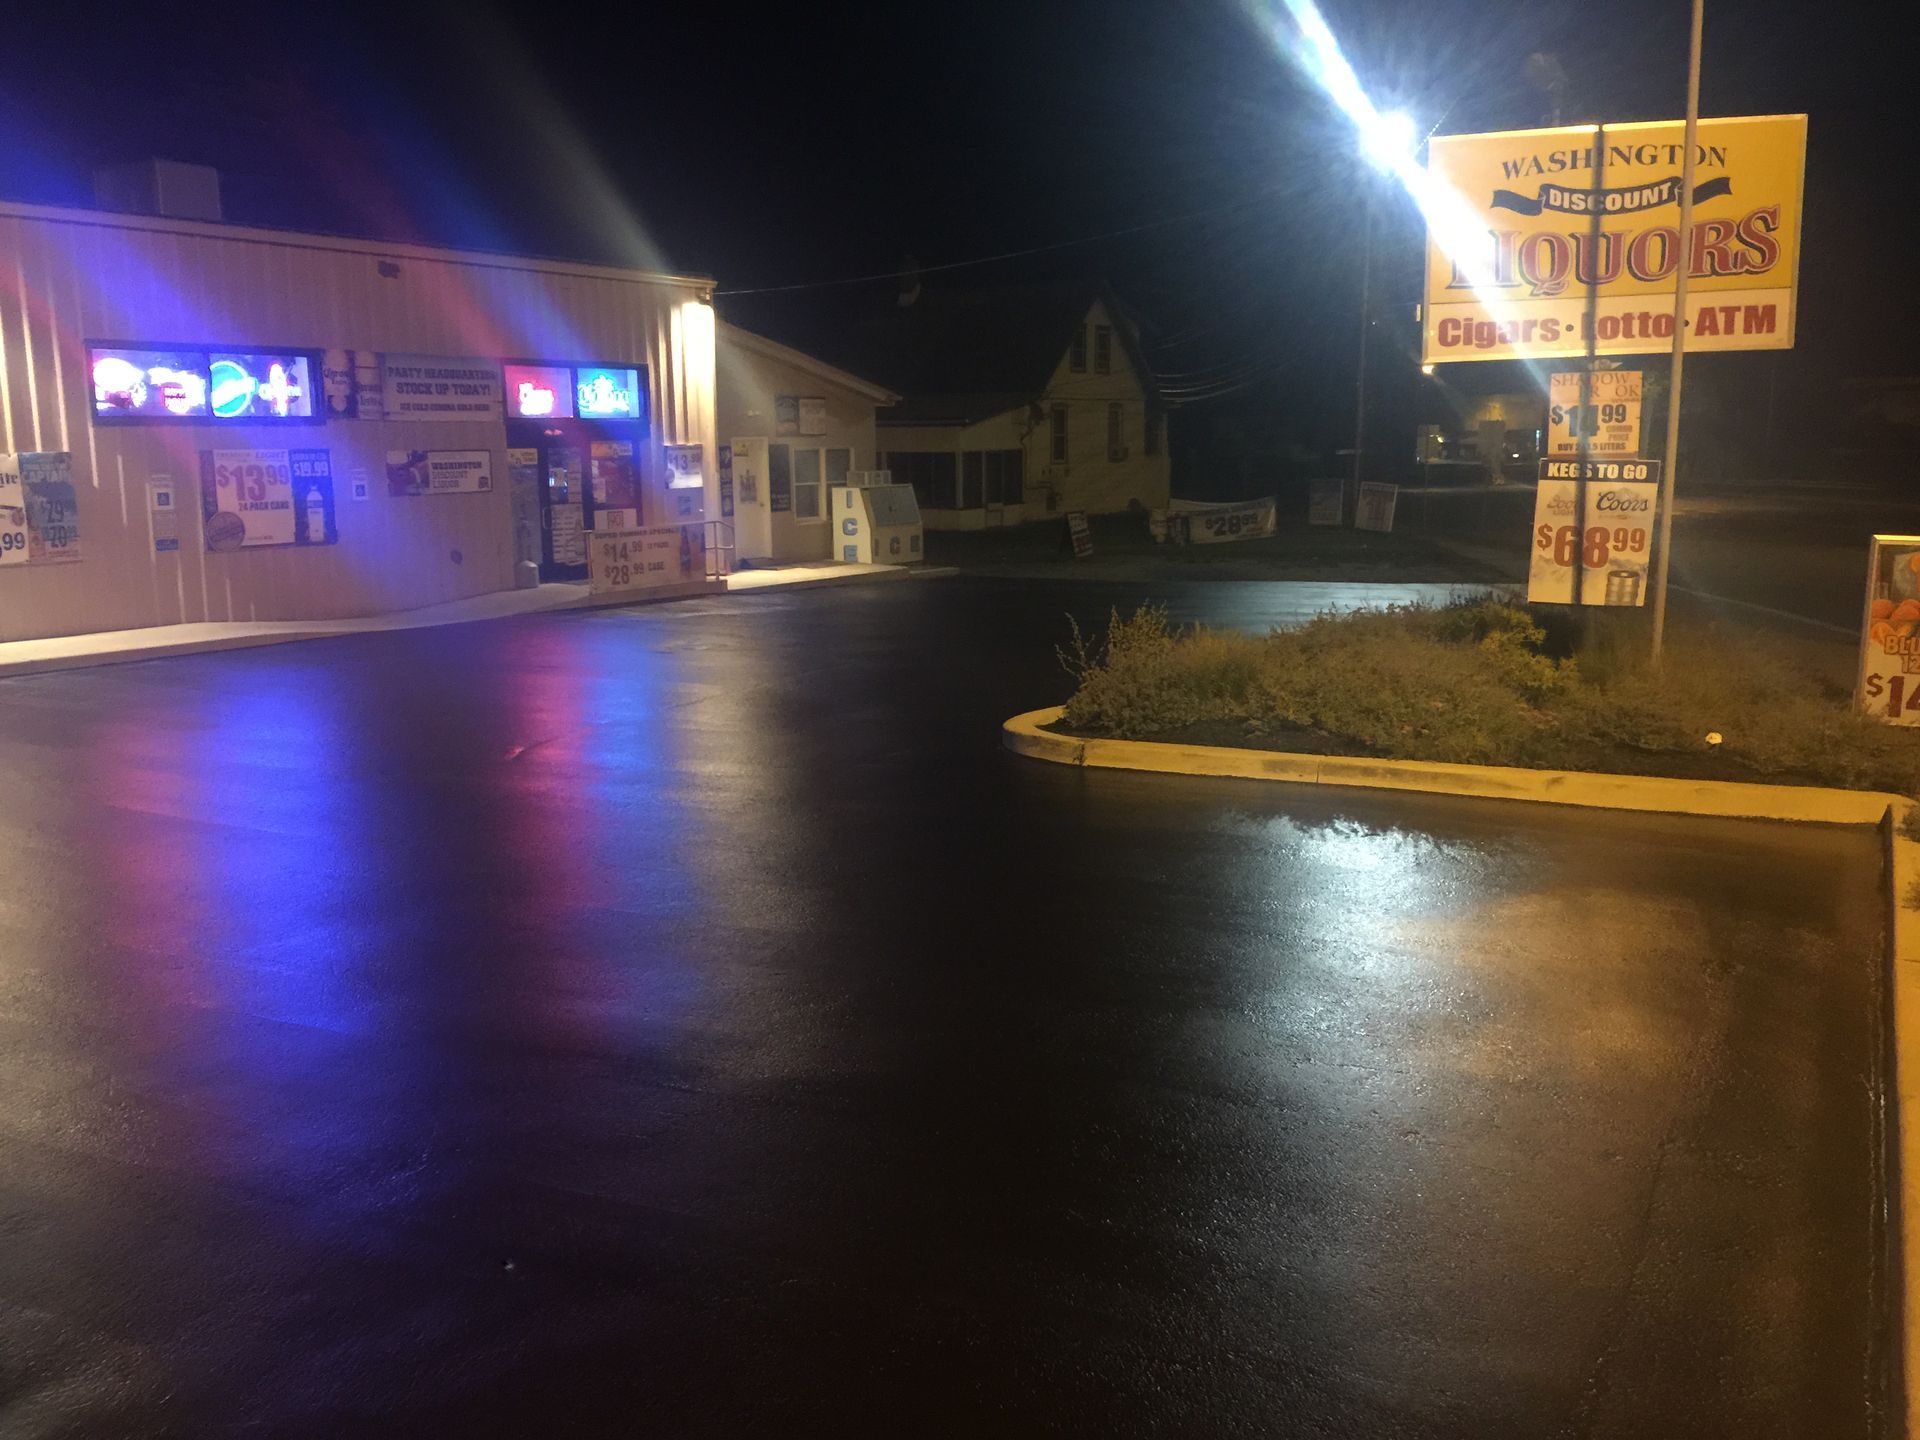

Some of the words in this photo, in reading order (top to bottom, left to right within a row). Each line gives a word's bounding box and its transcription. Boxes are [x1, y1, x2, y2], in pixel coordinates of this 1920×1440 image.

[1502, 144, 1727, 180] WASHNGTON
[1549, 182, 1671, 211] DISCOUNT
[1438, 317, 1560, 349] Cigars
[1695, 305, 1776, 337] ATM
[387, 367, 421, 378] PARTY
[396, 383, 433, 395] STOCK
[435, 384, 449, 395] UP
[452, 384, 490, 396] TODAY!
[1548, 463, 1592, 478] KEGS
[1597, 464, 1619, 479] TO
[1623, 464, 1647, 479] GO
[249, 501, 270, 511] PACK
[1596, 491, 1648, 511] Coors
